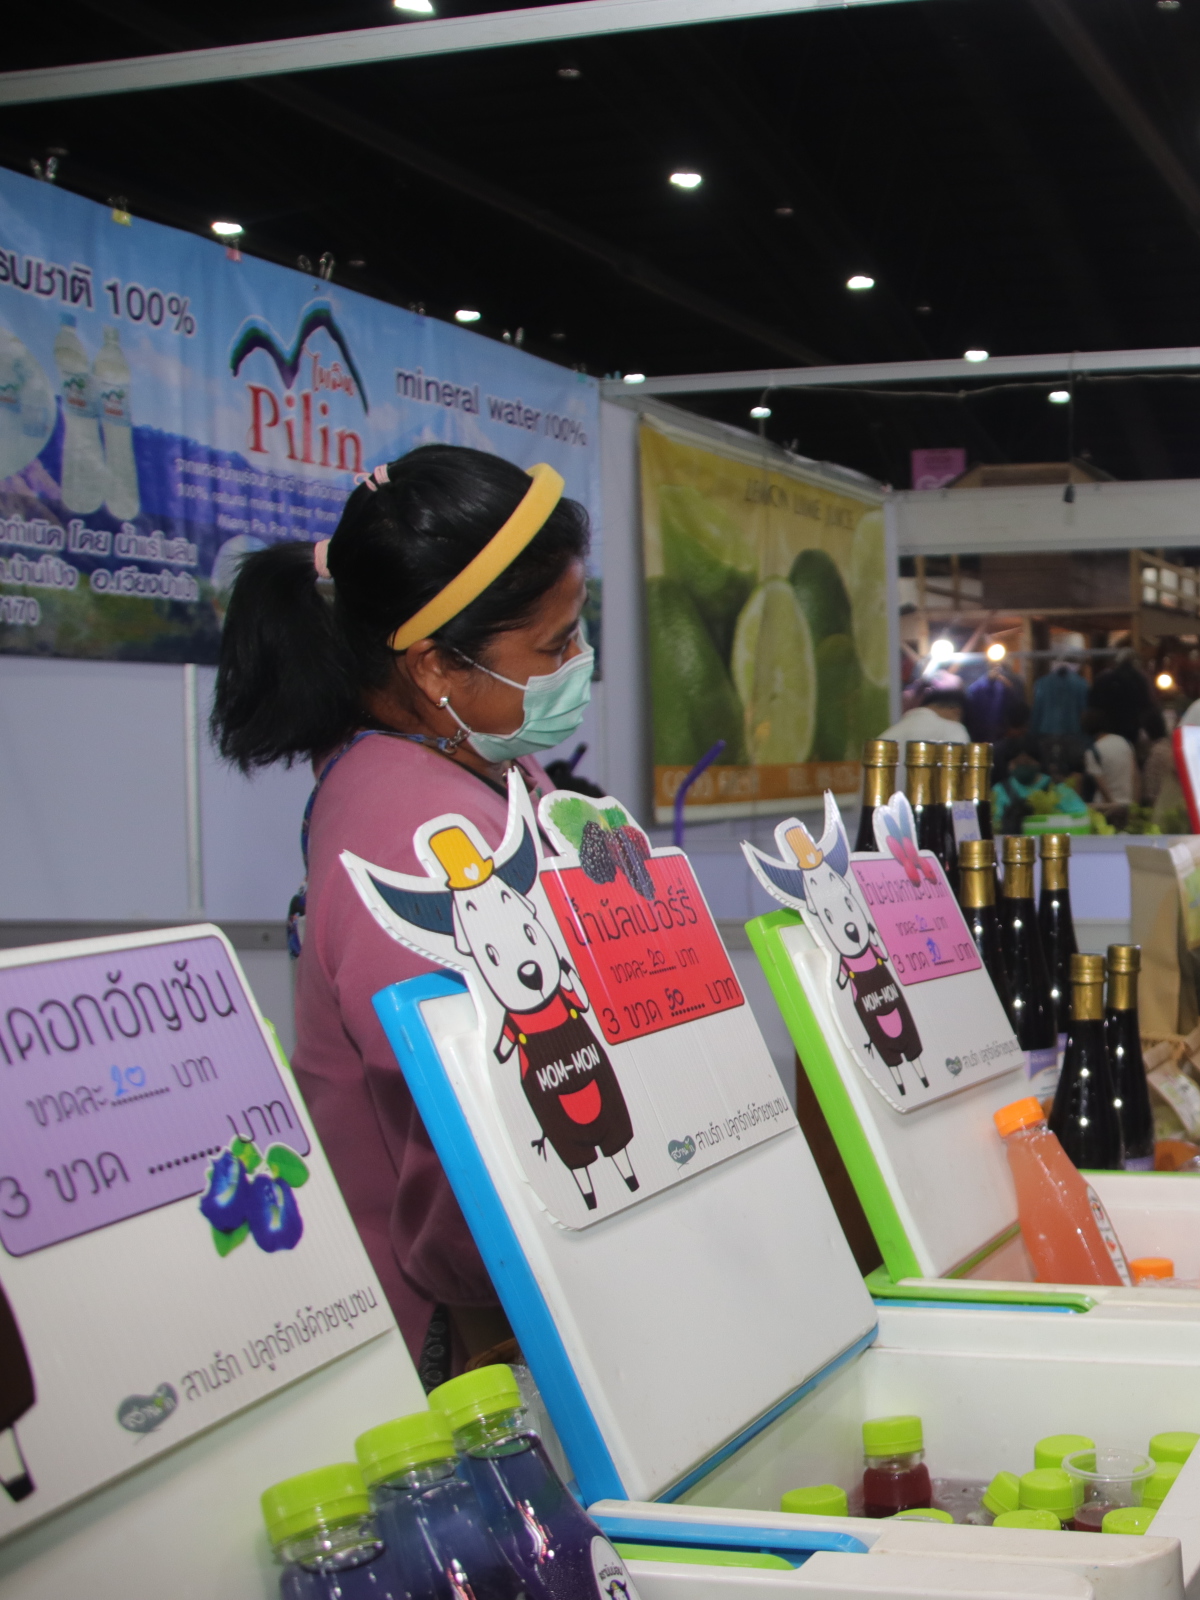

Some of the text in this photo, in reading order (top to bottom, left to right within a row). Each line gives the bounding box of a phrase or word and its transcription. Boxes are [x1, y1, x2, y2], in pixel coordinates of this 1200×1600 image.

[105, 280, 195, 336] 100%
[247, 383, 366, 474] Pilin
[396, 368, 588, 446] mineral water 100%
[69, 520, 112, 556] โดย
[565, 877, 698, 947] น้ำมัลเบอร์รี่
[610, 946, 700, 985] ขวดละ 20 บาท
[893, 953, 905, 974] 3
[602, 976, 741, 1035] 3 ขวด 50 บาท
[26, 1055, 220, 1127] ขวดละ 20 บาท
[535, 1042, 601, 1092] MOM-MON
[0, 1100, 294, 1220] 3 ขวด บาท
[181, 1349, 244, 1401] สานรัก
